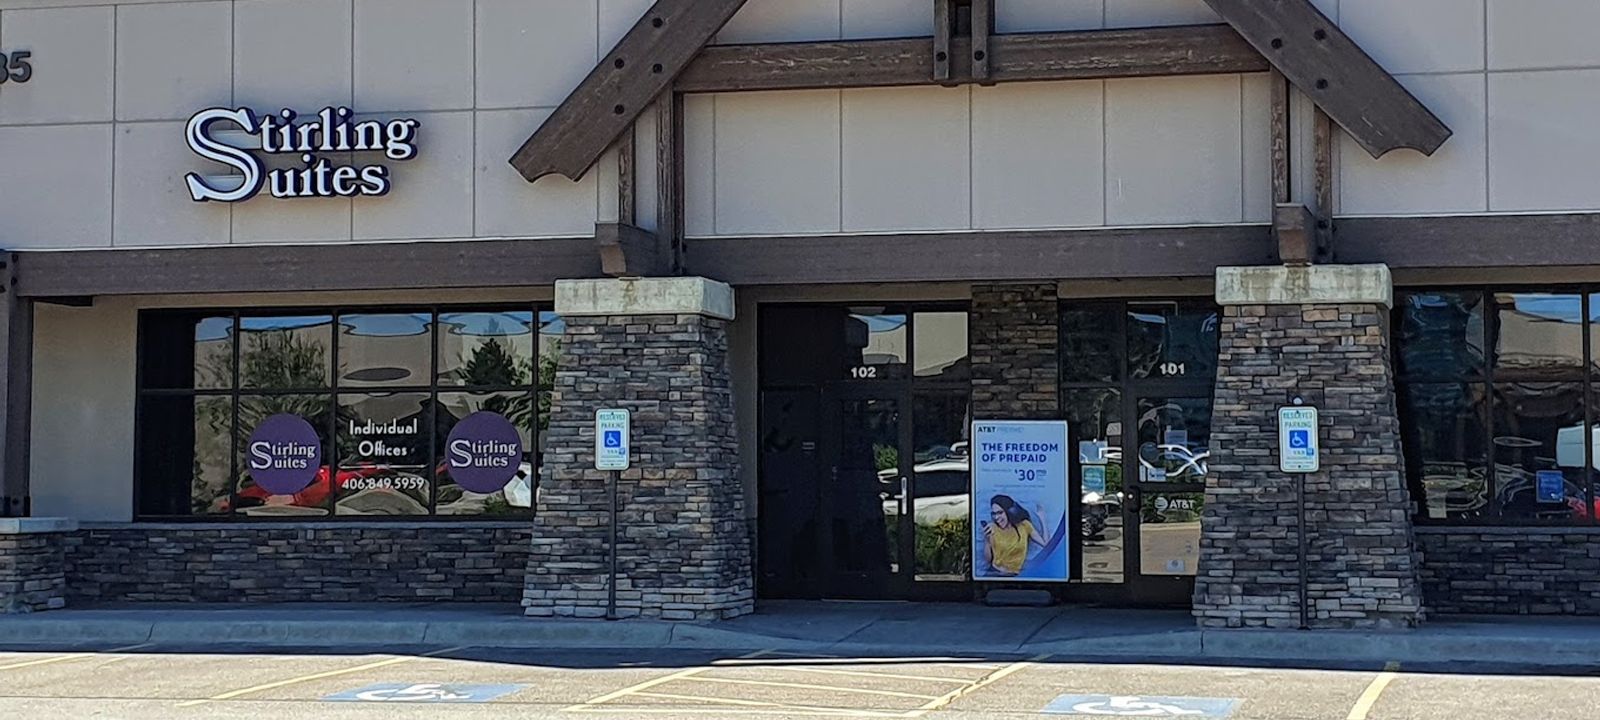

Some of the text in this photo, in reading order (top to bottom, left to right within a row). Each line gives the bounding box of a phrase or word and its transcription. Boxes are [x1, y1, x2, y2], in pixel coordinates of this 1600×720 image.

[185, 106, 419, 202] Stirling
[850, 366, 877, 379] 102
[1159, 362, 1186, 375] 101
[349, 418, 418, 435] Individual
[358, 440, 408, 456] Offices
[450, 439, 517, 467] Stirling
[981, 443, 1059, 452] THE FREEDOM
[250, 441, 316, 469] Stirling
[981, 454, 1047, 463] OF PREPAID
[341, 477, 425, 490] 406.849.5959
[1169, 499, 1195, 510] AT&T
